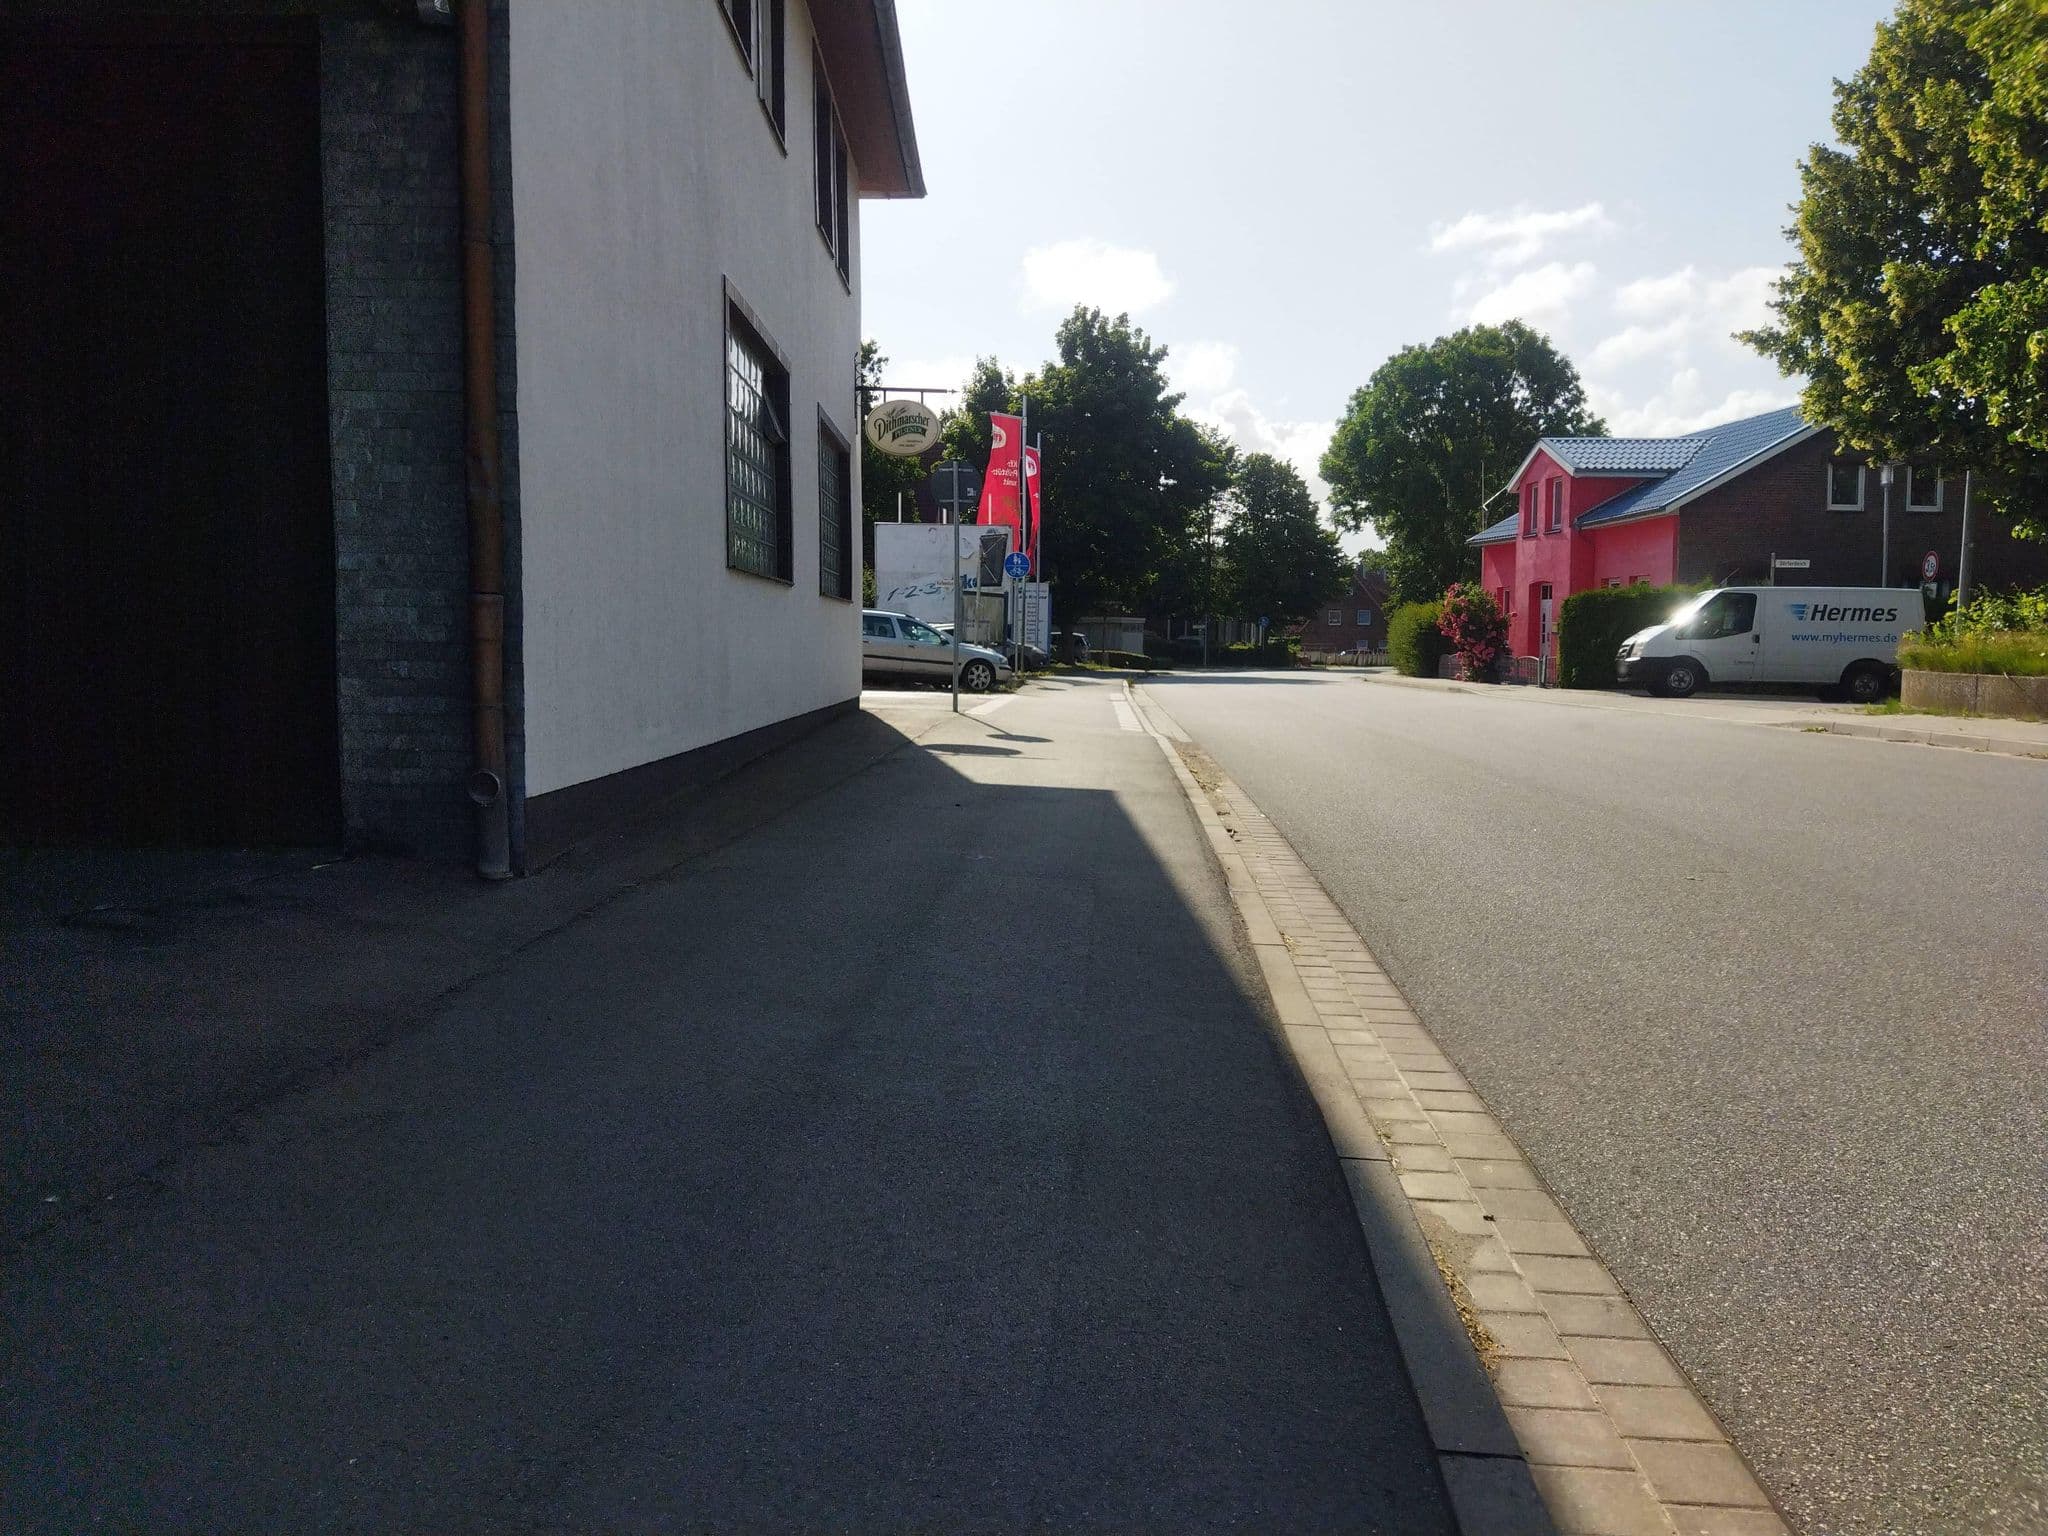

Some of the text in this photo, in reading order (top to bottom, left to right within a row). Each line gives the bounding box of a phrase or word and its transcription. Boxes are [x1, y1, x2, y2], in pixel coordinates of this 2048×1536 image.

[874, 412, 930, 441] Dithmarscher
[1810, 604, 1898, 622] Hermes
[1791, 632, 1897, 643] www.myhermes.de
